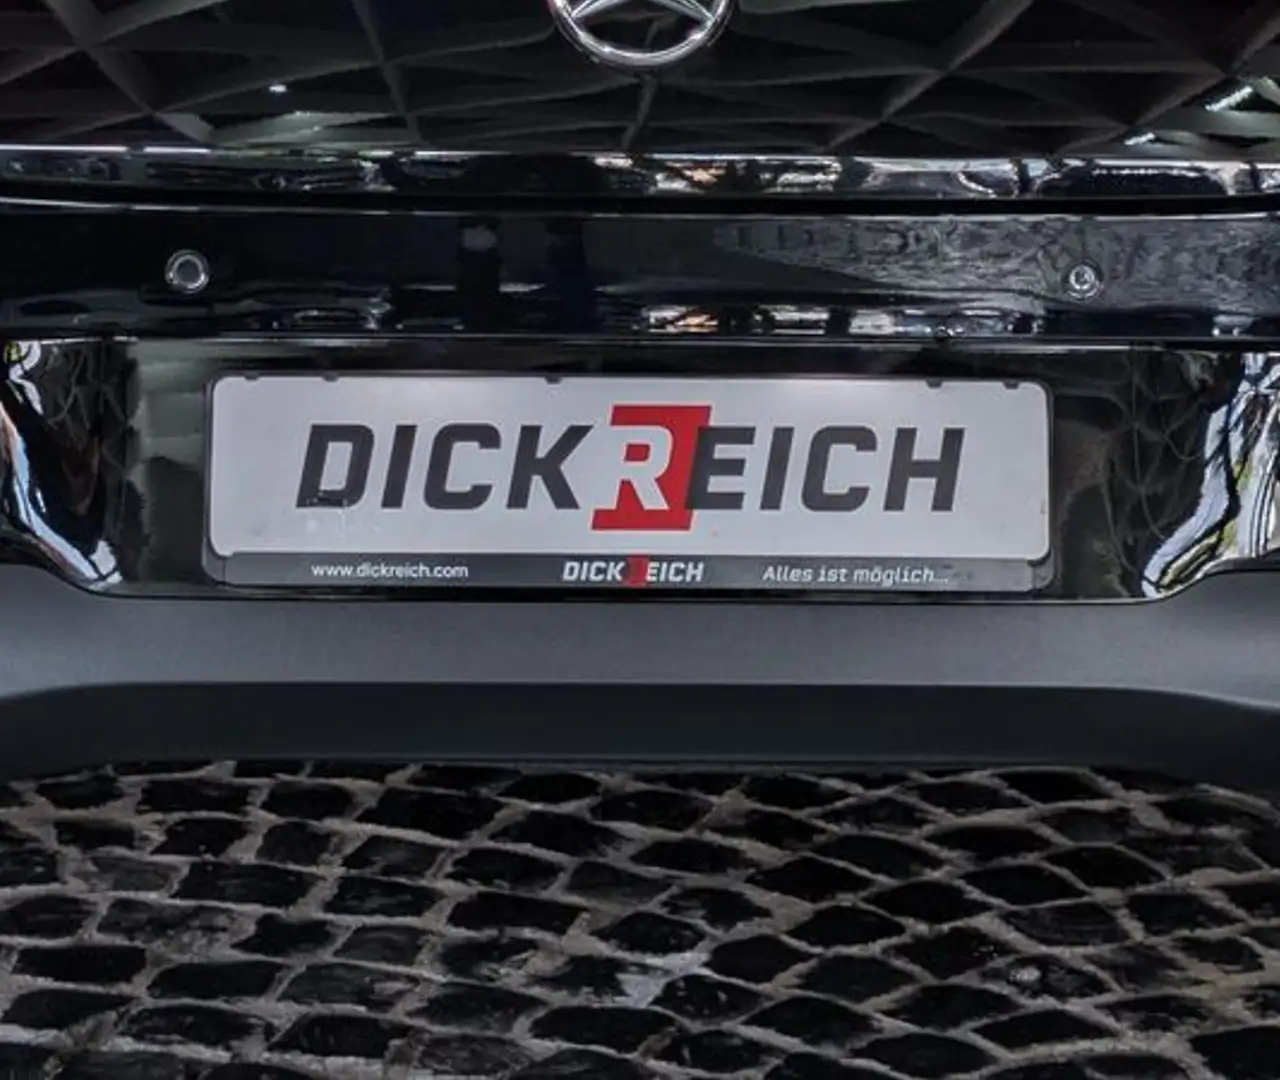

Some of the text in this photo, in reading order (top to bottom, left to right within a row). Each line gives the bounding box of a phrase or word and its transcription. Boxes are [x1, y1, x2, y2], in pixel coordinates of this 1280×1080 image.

[296, 420, 965, 514] DICKREICH
[310, 561, 469, 579] www.dickreich.com
[562, 560, 704, 582] DICKEICH
[762, 565, 813, 582] Alles
[817, 565, 847, 582] ist
